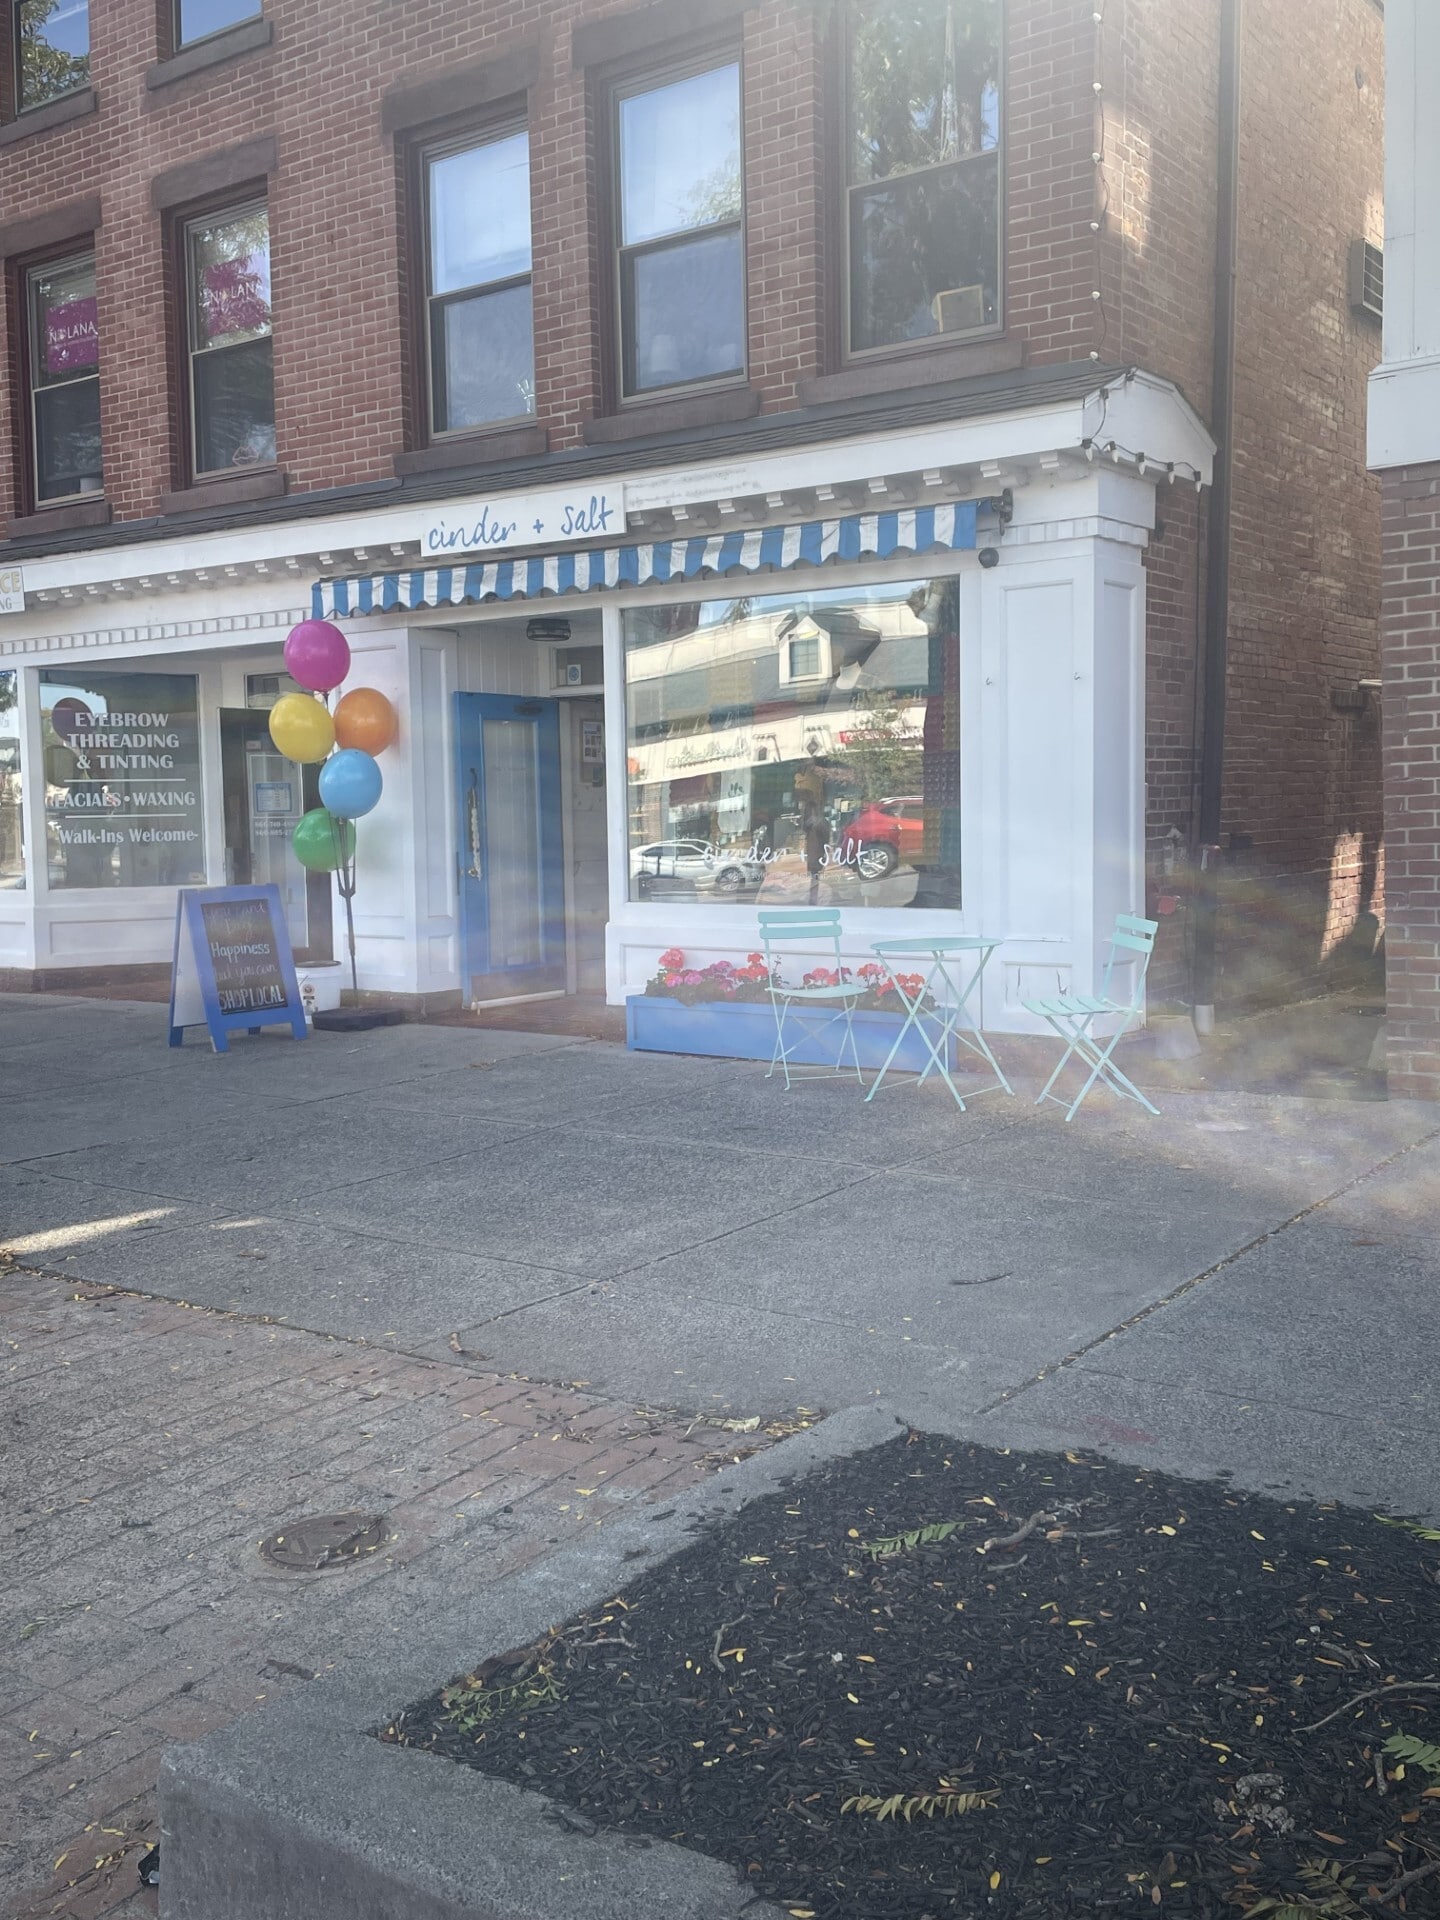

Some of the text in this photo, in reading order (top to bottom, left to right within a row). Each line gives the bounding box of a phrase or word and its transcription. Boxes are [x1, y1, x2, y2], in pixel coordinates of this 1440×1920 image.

[428, 505, 517, 550] cinder
[532, 518, 545, 534] +
[74, 712, 169, 727] EYEBROW
[66, 733, 180, 748] THREADING
[76, 754, 174, 769] & TINTING
[54, 791, 196, 807] FACIALS WAXING
[210, 942, 270, 964] Happiness
[217, 984, 285, 1010] SHOP LOCAL
